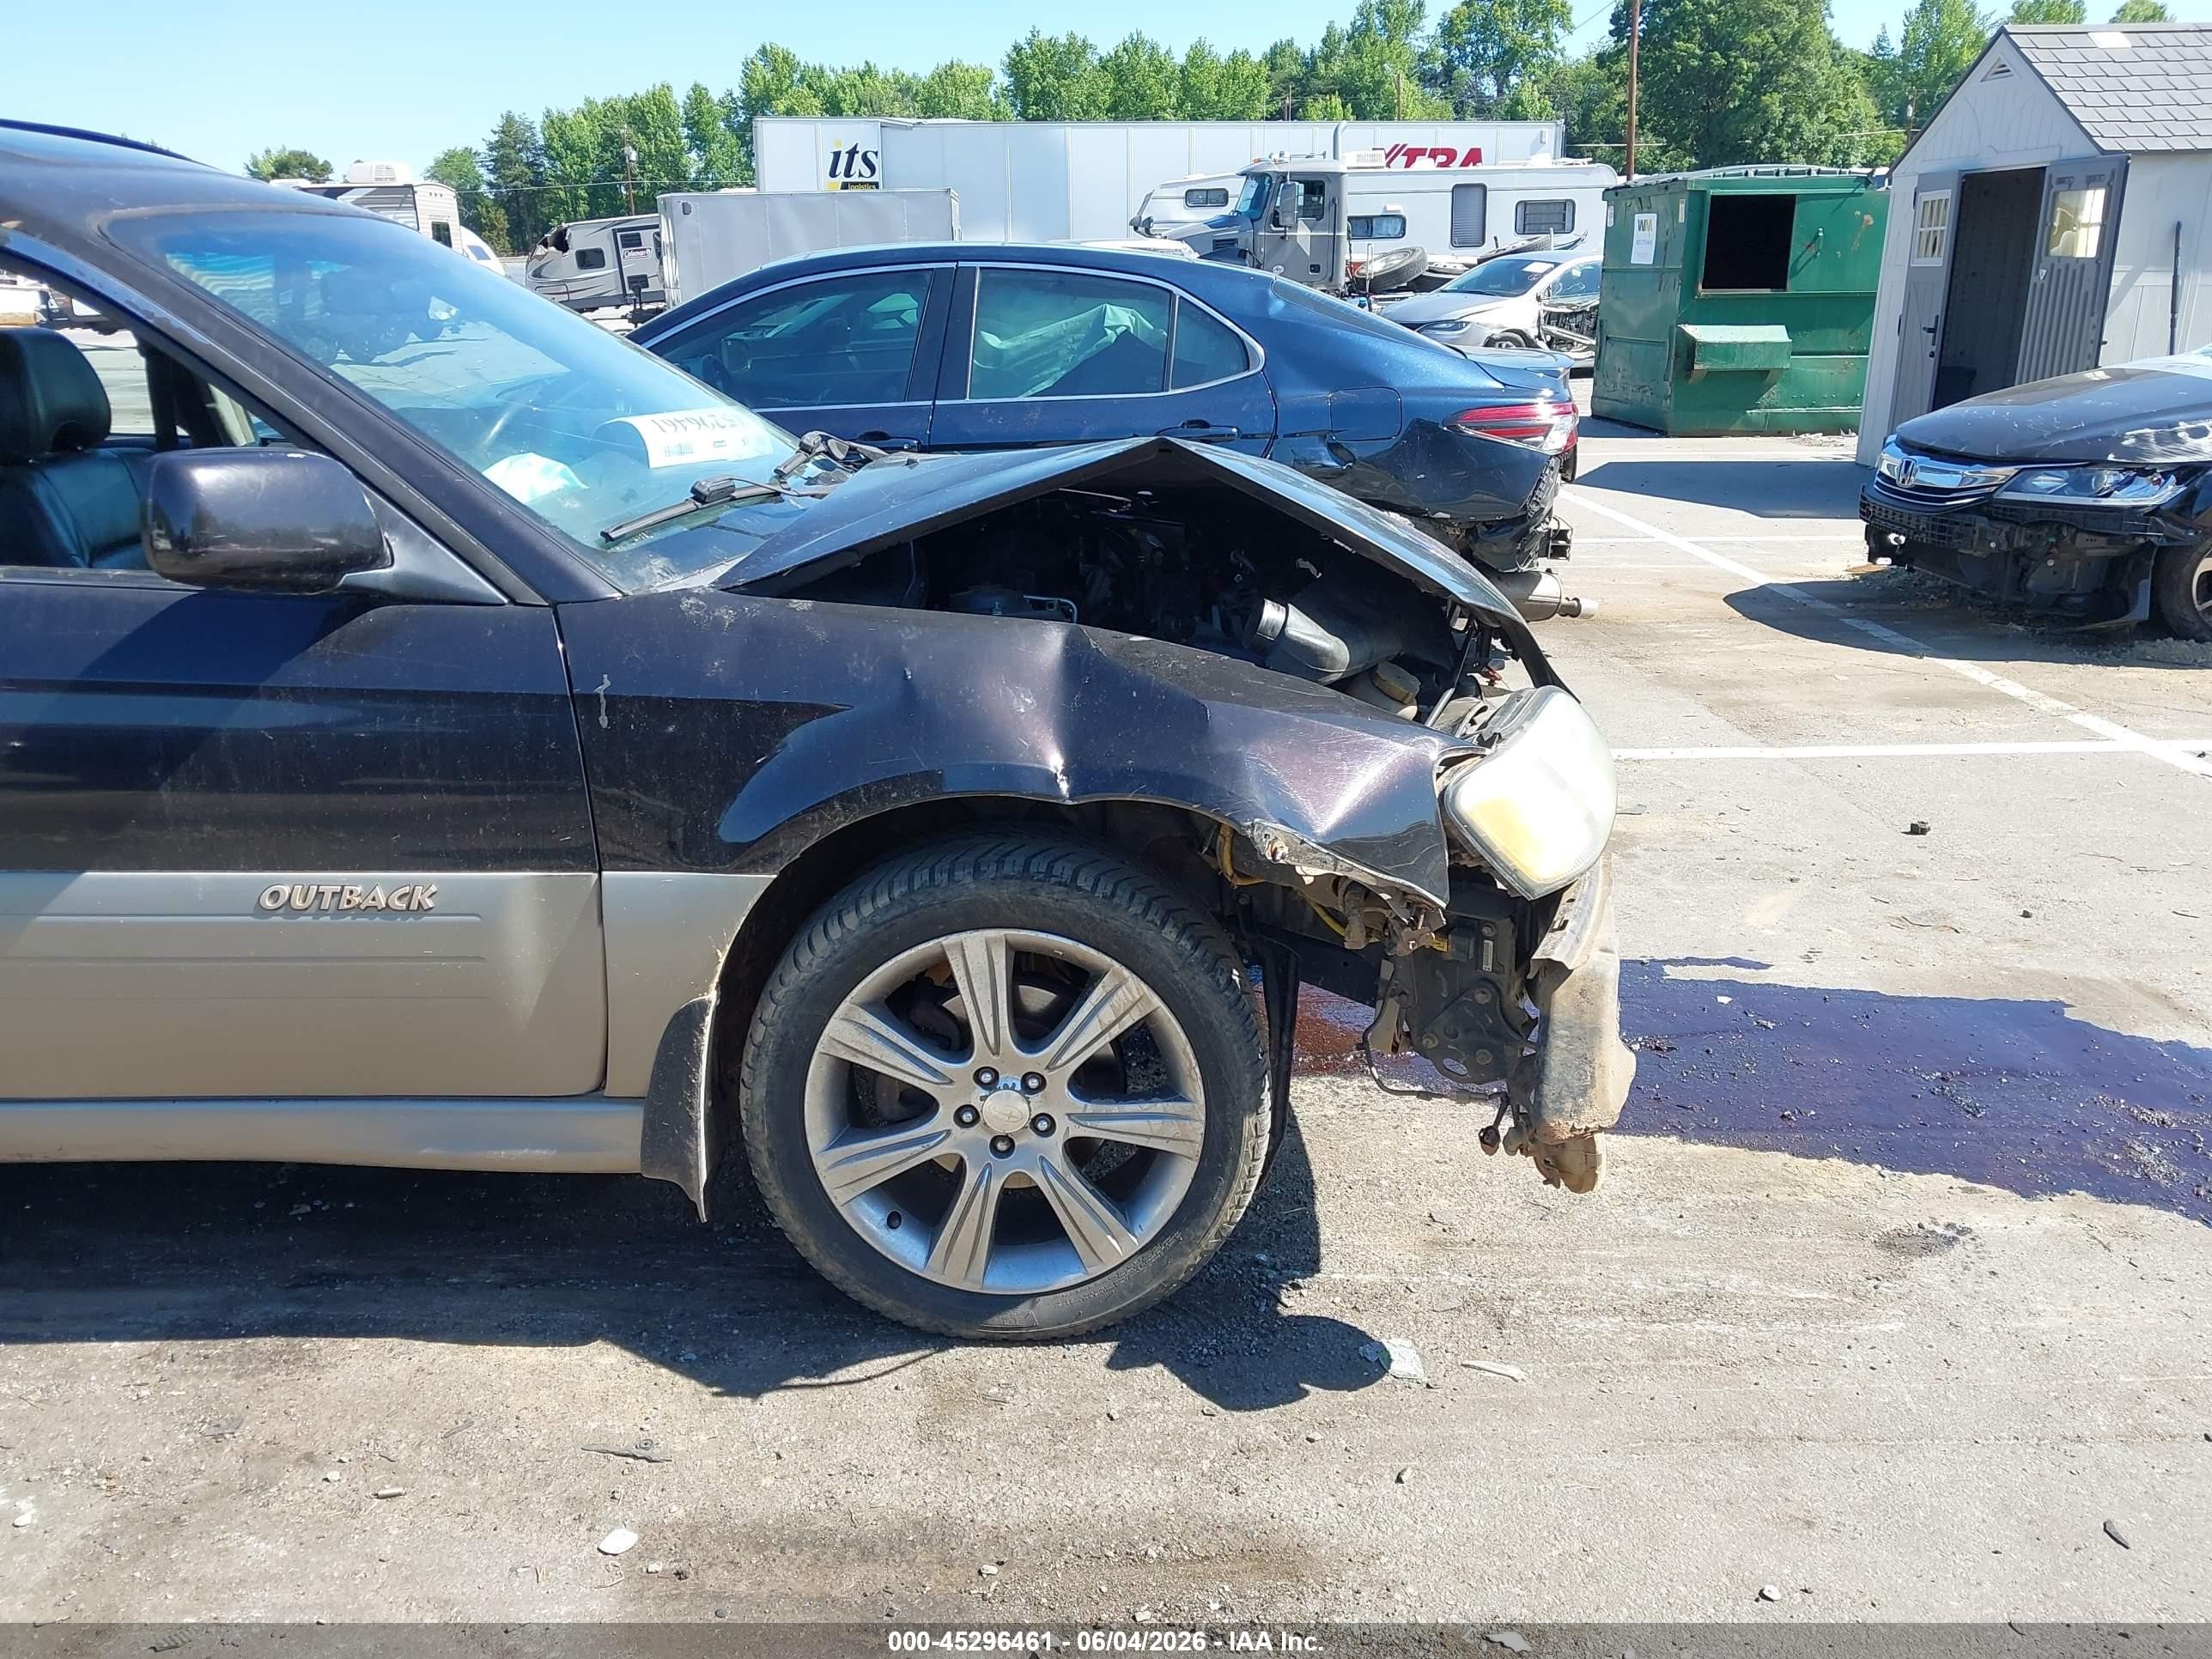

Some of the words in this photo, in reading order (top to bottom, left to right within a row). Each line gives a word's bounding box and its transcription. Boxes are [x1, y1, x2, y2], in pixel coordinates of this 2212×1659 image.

[828, 138, 878, 178] its
[1638, 219, 1653, 232] WM
[258, 884, 438, 911] OUTBACK
